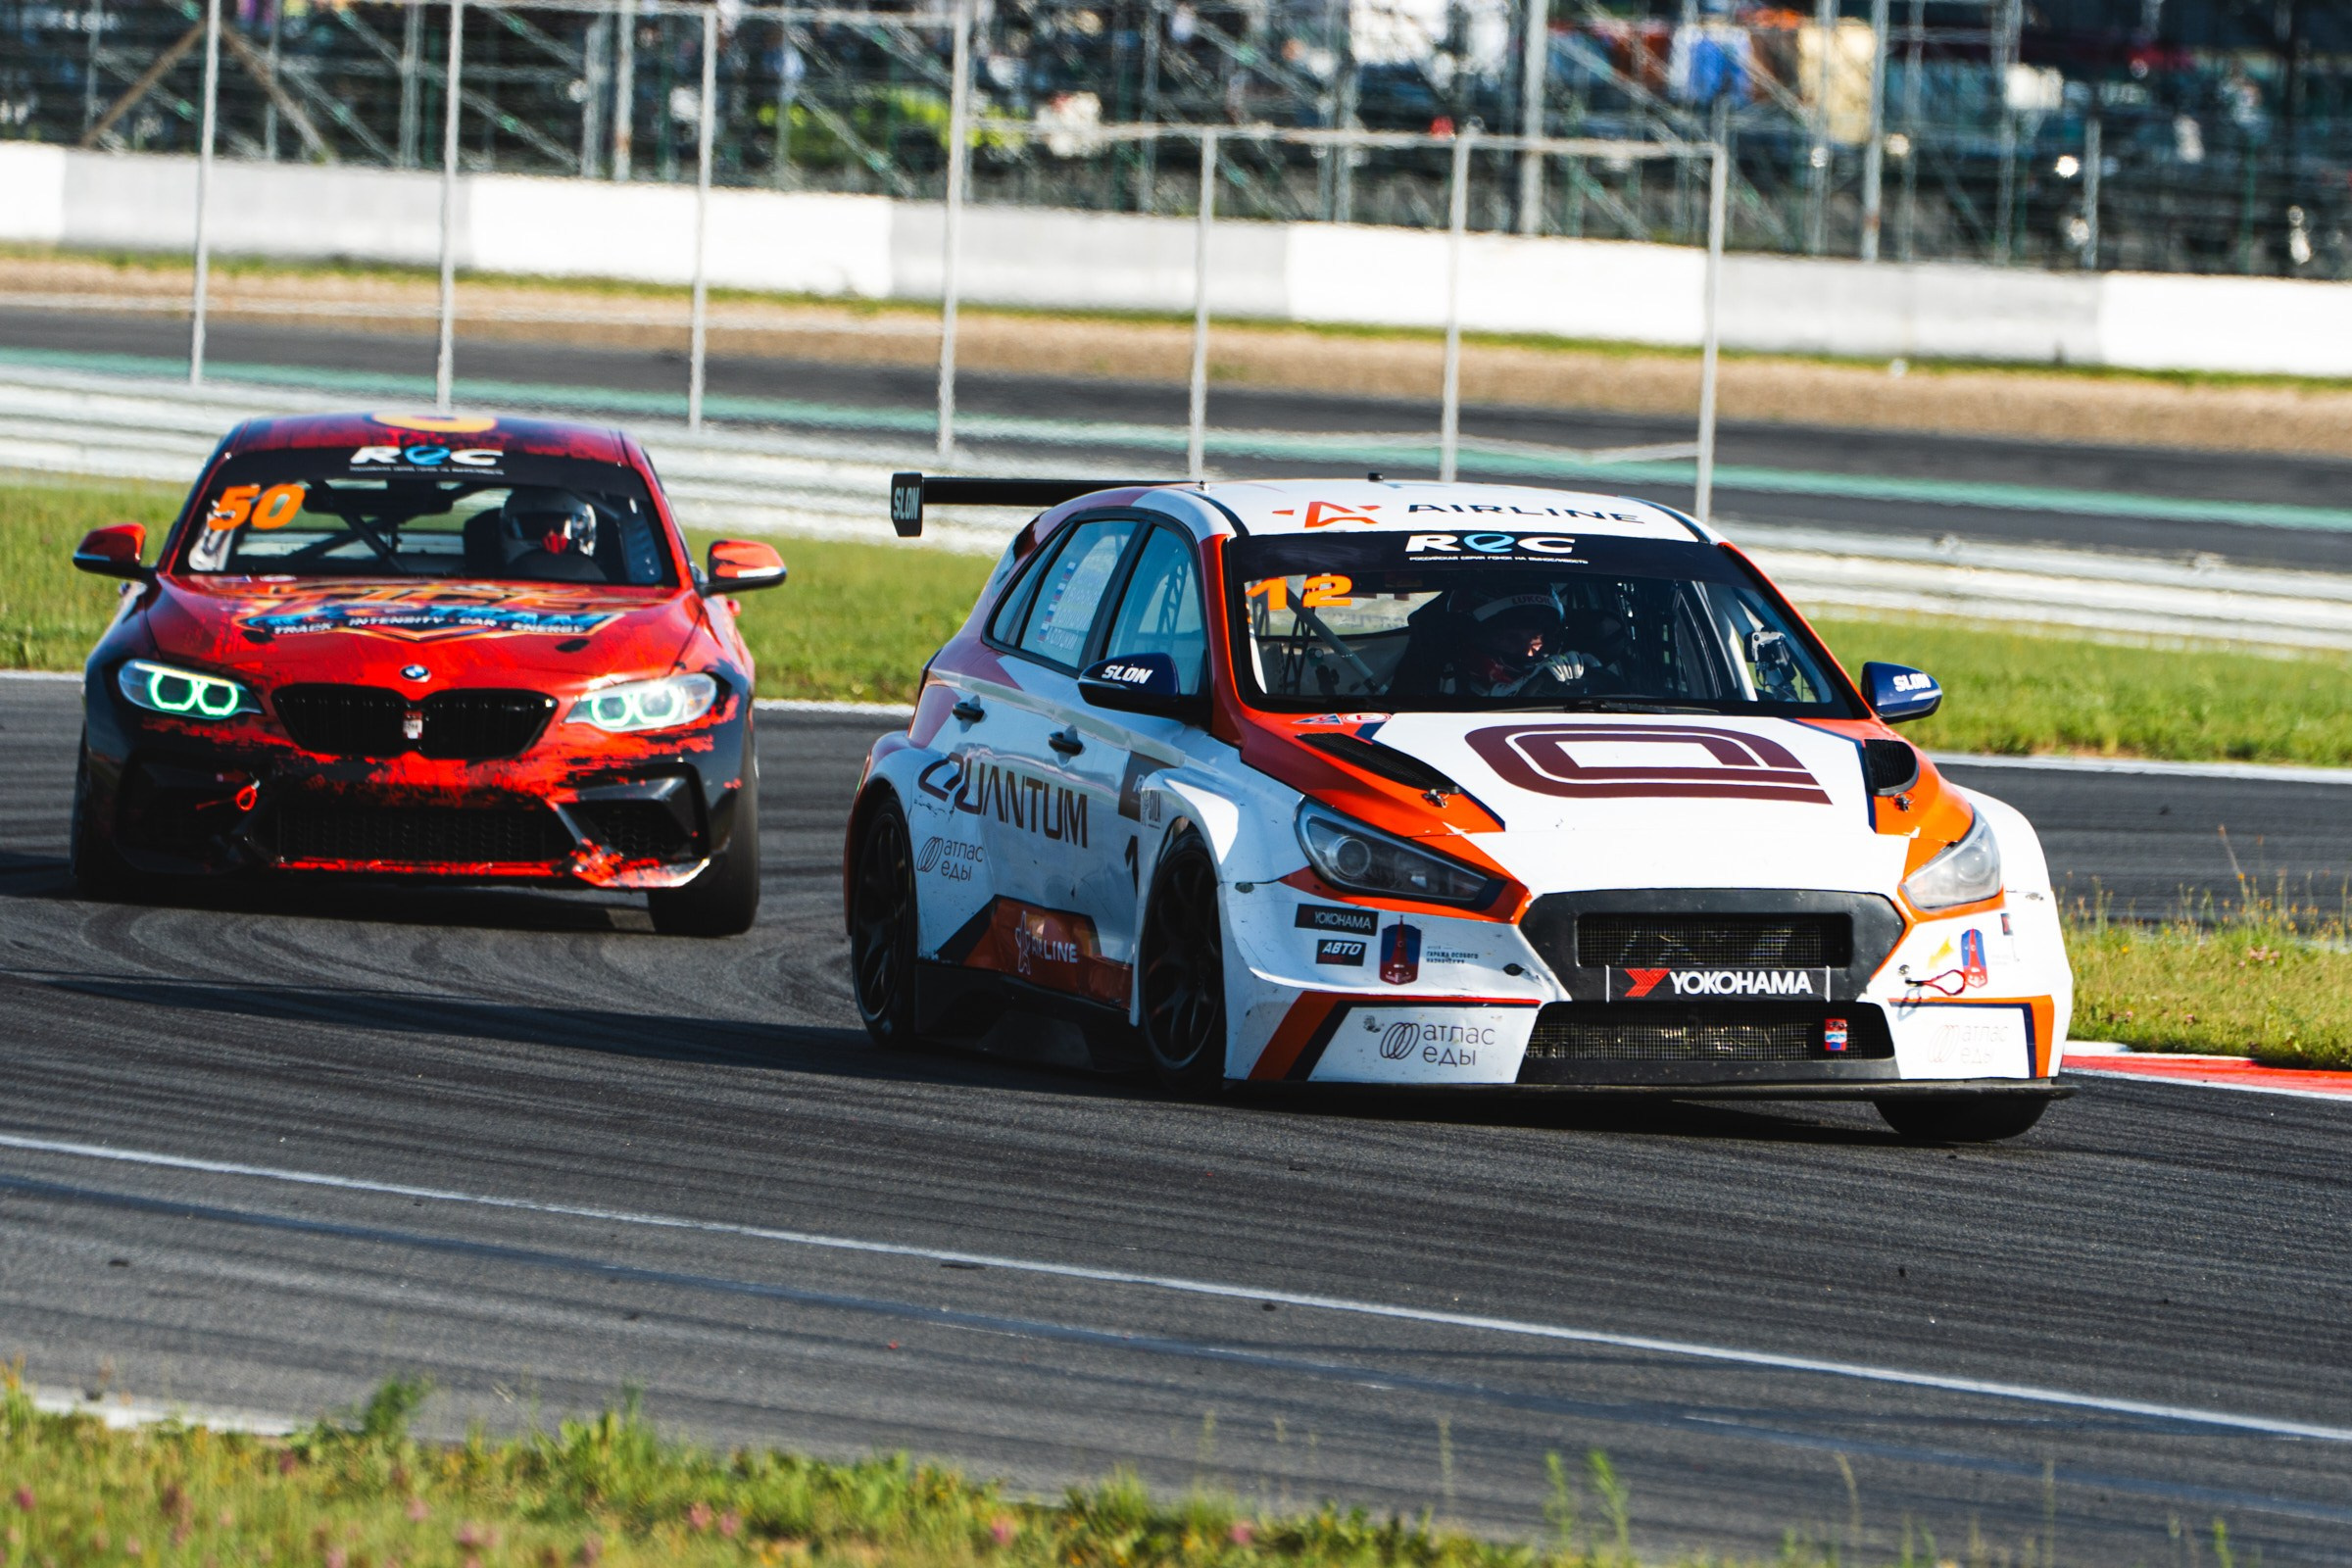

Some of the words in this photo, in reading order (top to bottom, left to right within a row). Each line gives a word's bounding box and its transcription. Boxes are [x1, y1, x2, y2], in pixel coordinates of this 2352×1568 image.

[207, 482, 306, 531] 50
[893, 486, 920, 520] SLON
[1408, 504, 1645, 524] AIRLINE
[1246, 573, 1352, 612] 12
[272, 621, 332, 635] TRACK
[348, 616, 446, 627] INTENSITY
[459, 617, 498, 628] CAR
[510, 621, 586, 634] ENERGY
[1101, 664, 1153, 685] SLON
[1892, 672, 1932, 692] SLON
[917, 751, 1088, 850] QUANTUM
[943, 840, 984, 862] атлас
[941, 860, 972, 881] еды
[1314, 911, 1372, 930] YOKOHAMA
[1322, 942, 1362, 956] АВТО
[1669, 970, 1813, 995] YOKOHAMA
[1423, 1024, 1496, 1046] атлас
[1423, 1045, 1476, 1068] еды
